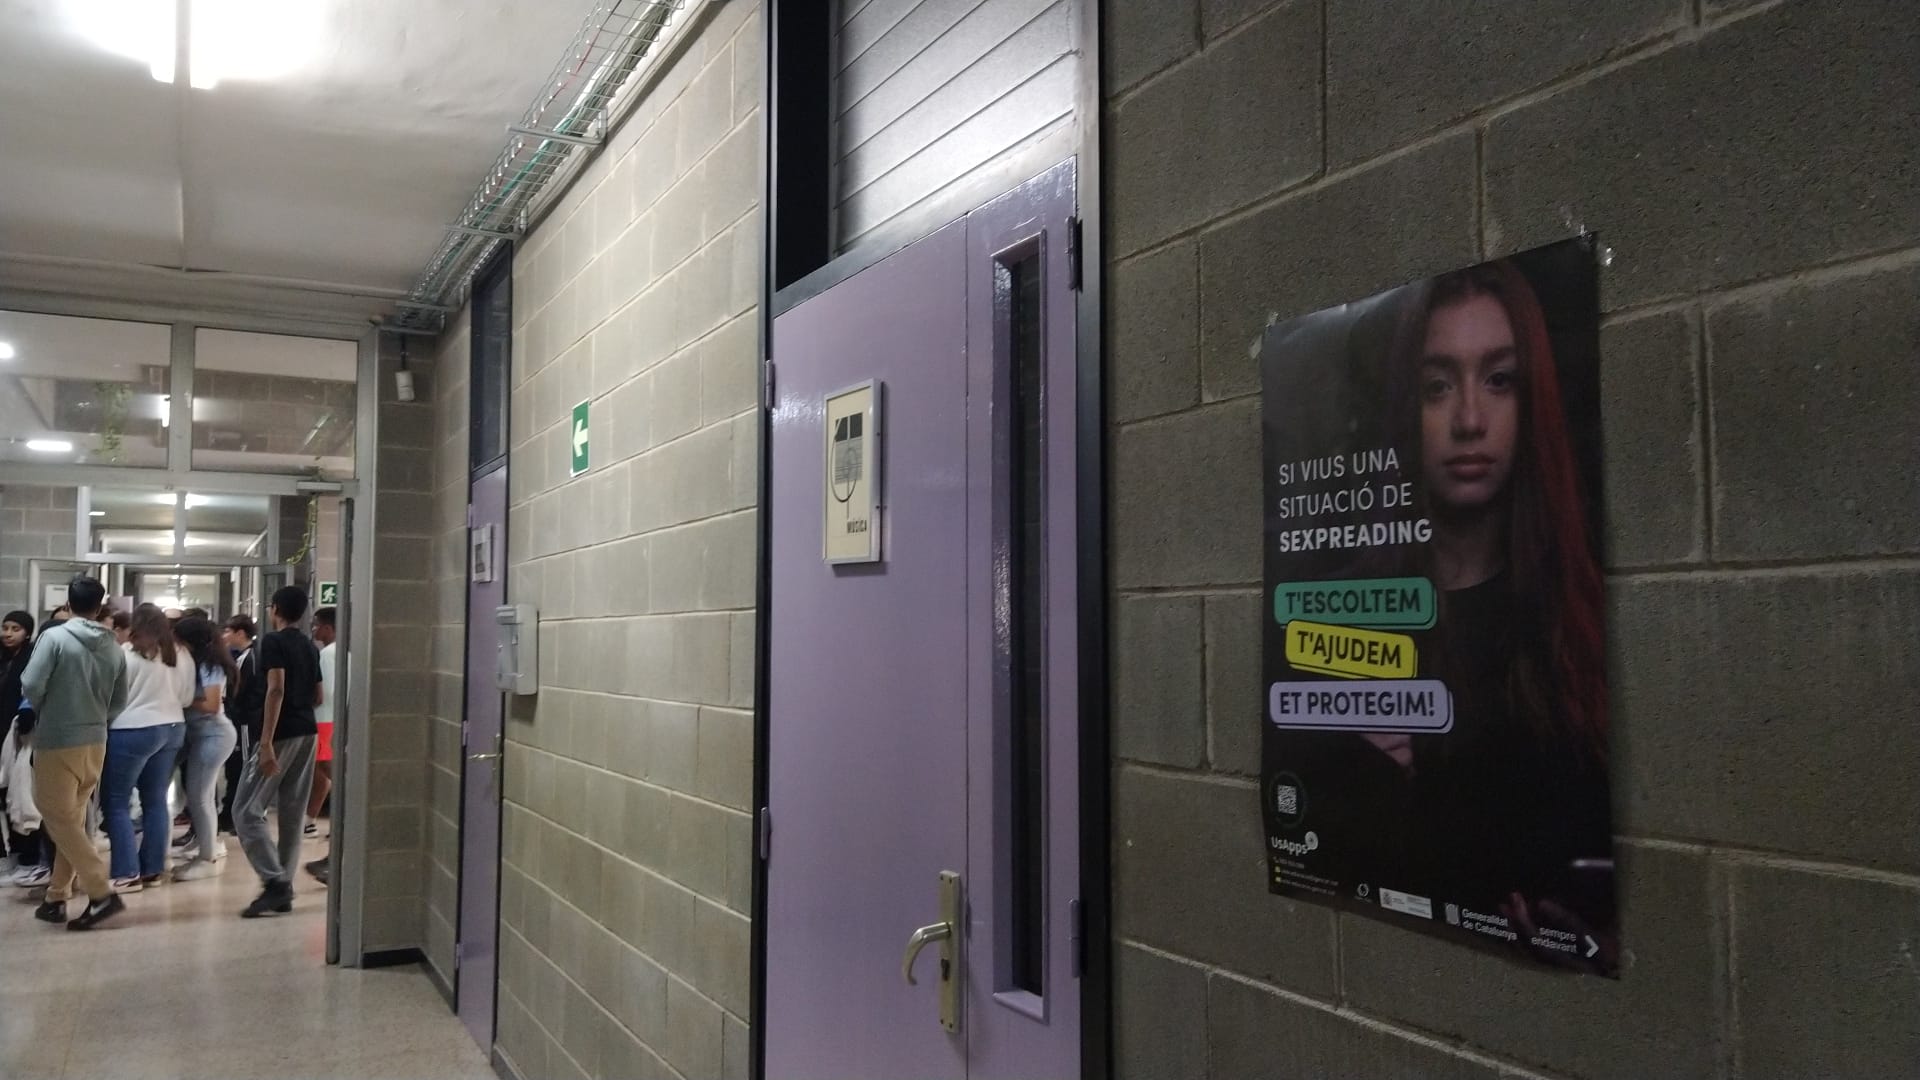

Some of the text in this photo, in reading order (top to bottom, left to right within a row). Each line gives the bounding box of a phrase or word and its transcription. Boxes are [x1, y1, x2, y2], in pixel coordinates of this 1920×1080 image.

[1279, 447, 1400, 485] SI VIUS UNA
[1279, 480, 1413, 519] SITUACIÓ DE
[1279, 518, 1433, 553] SEXPREADING
[1285, 587, 1421, 614] T'ESCOLTEM
[1297, 630, 1402, 669] T'AJUDEM
[1279, 690, 1435, 717] ET PROTEGIM!
[1461, 908, 1509, 928] Generalitat
[1462, 920, 1518, 942] de Catalunya
[1539, 926, 1577, 942] sempre
